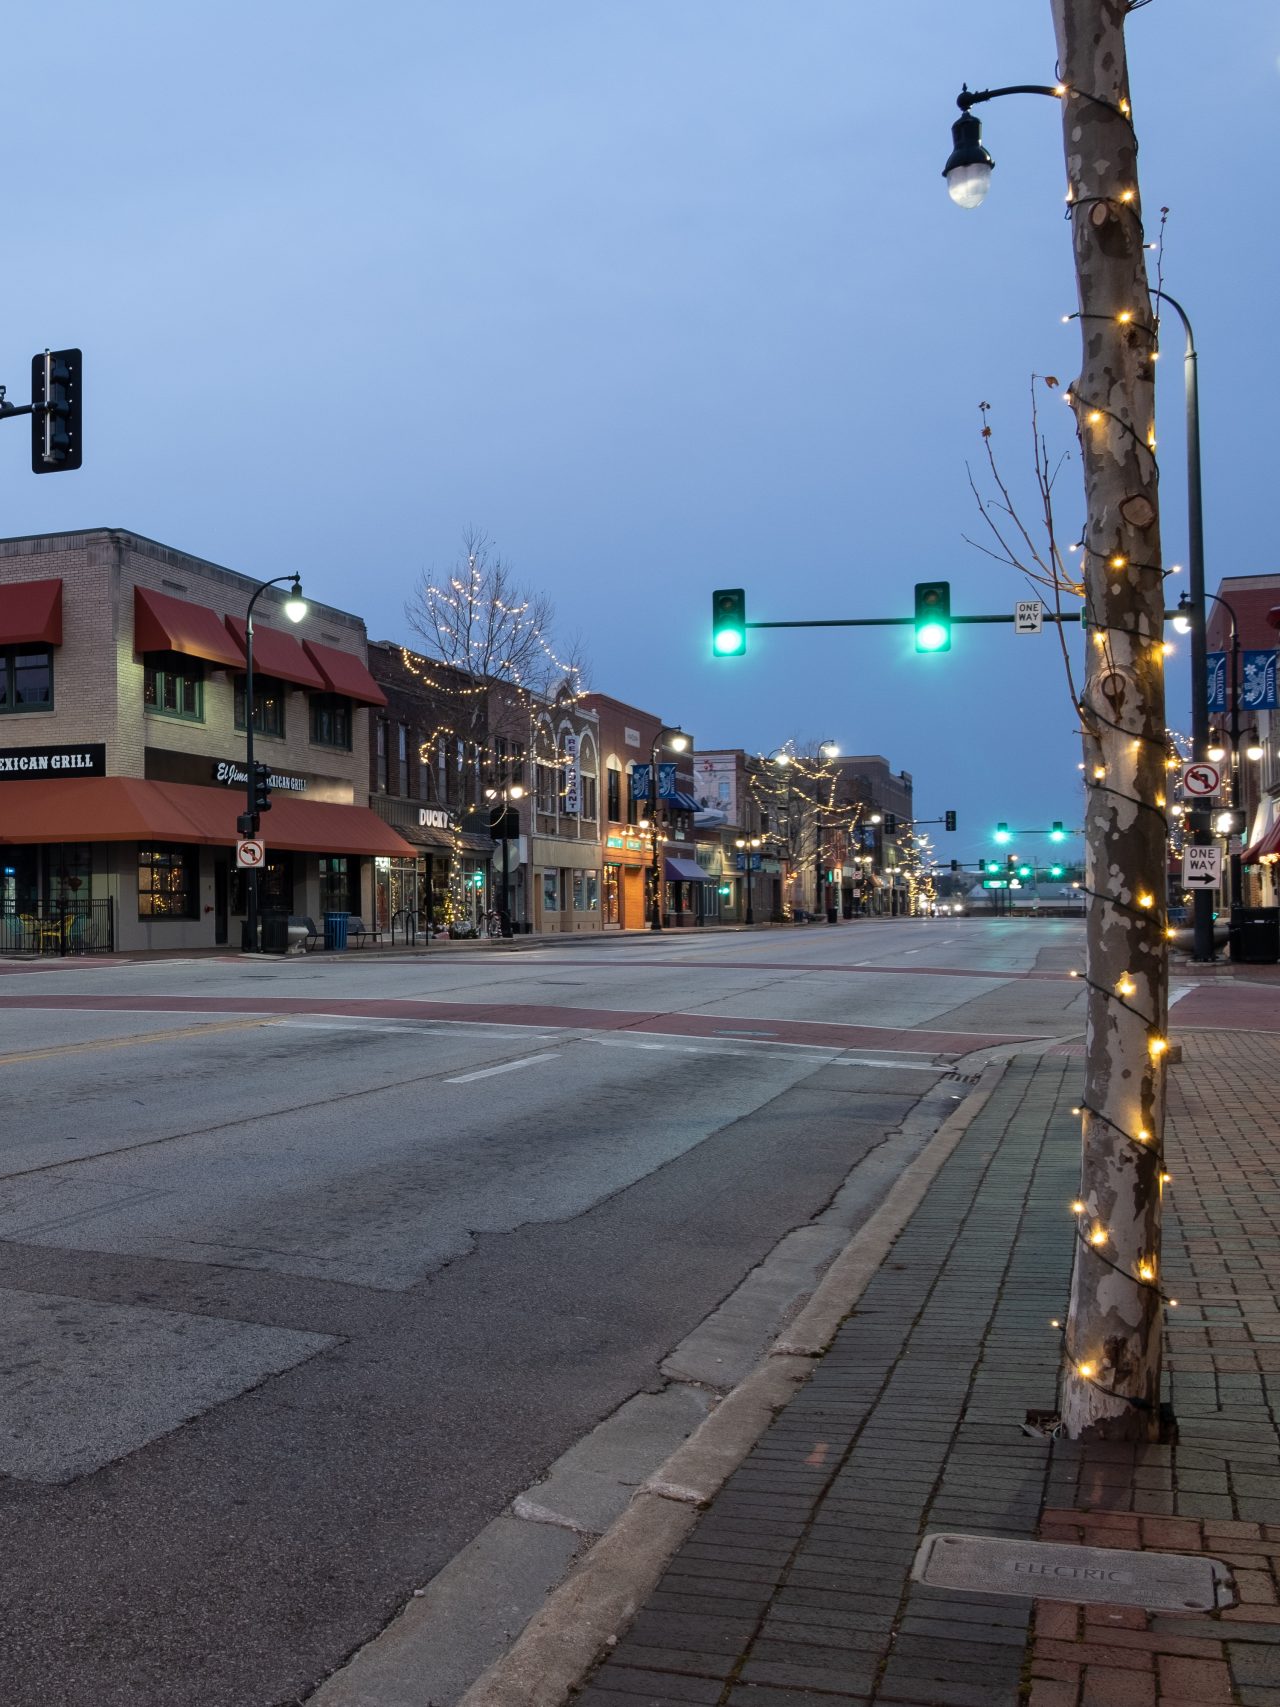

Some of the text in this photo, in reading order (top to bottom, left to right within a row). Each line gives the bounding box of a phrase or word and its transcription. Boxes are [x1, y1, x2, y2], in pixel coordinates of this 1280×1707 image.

[1019, 613, 1039, 621] WAY
[1267, 667, 1275, 702] WELCOME
[51, 754, 94, 768] GRILL
[217, 762, 229, 780] El
[291, 778, 308, 792] GRILL
[1190, 849, 1215, 858] ONE
[1190, 861, 1216, 870] WAY
[1014, 1562, 1121, 1582] ELECTRIC
